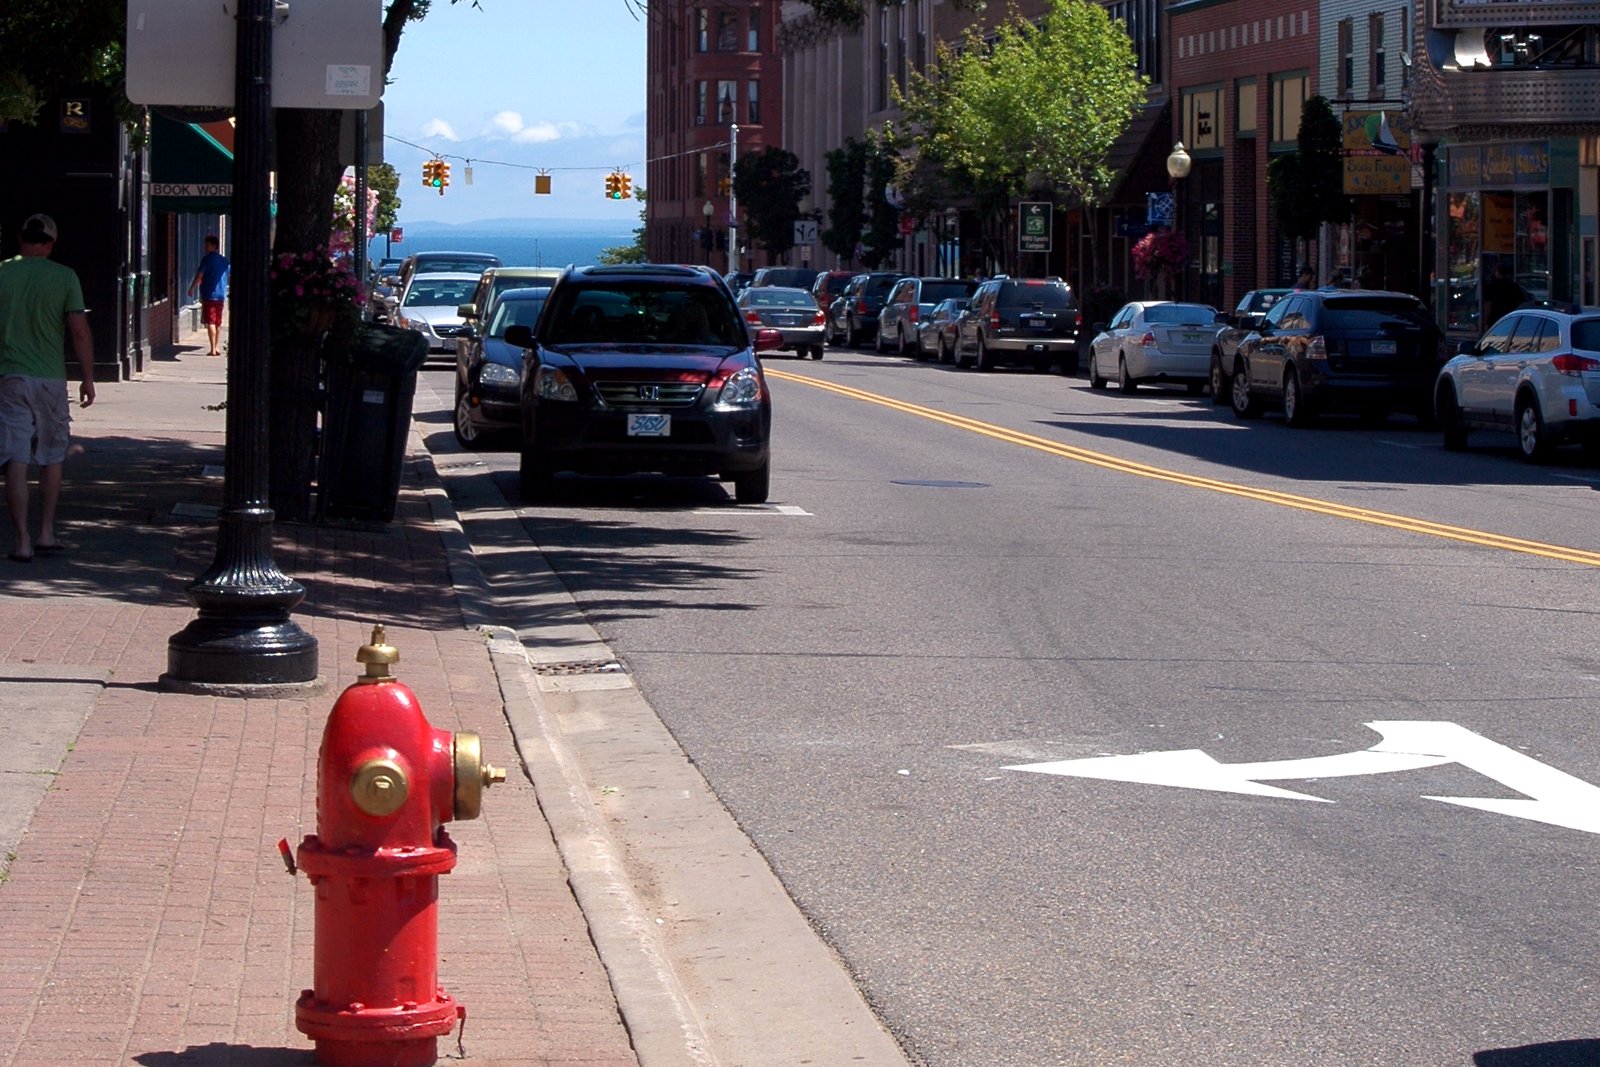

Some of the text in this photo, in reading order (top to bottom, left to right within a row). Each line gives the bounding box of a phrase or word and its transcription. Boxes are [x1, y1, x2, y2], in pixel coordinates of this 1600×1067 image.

[153, 184, 234, 195] BOOK WORL
[631, 416, 668, 431] SISU
